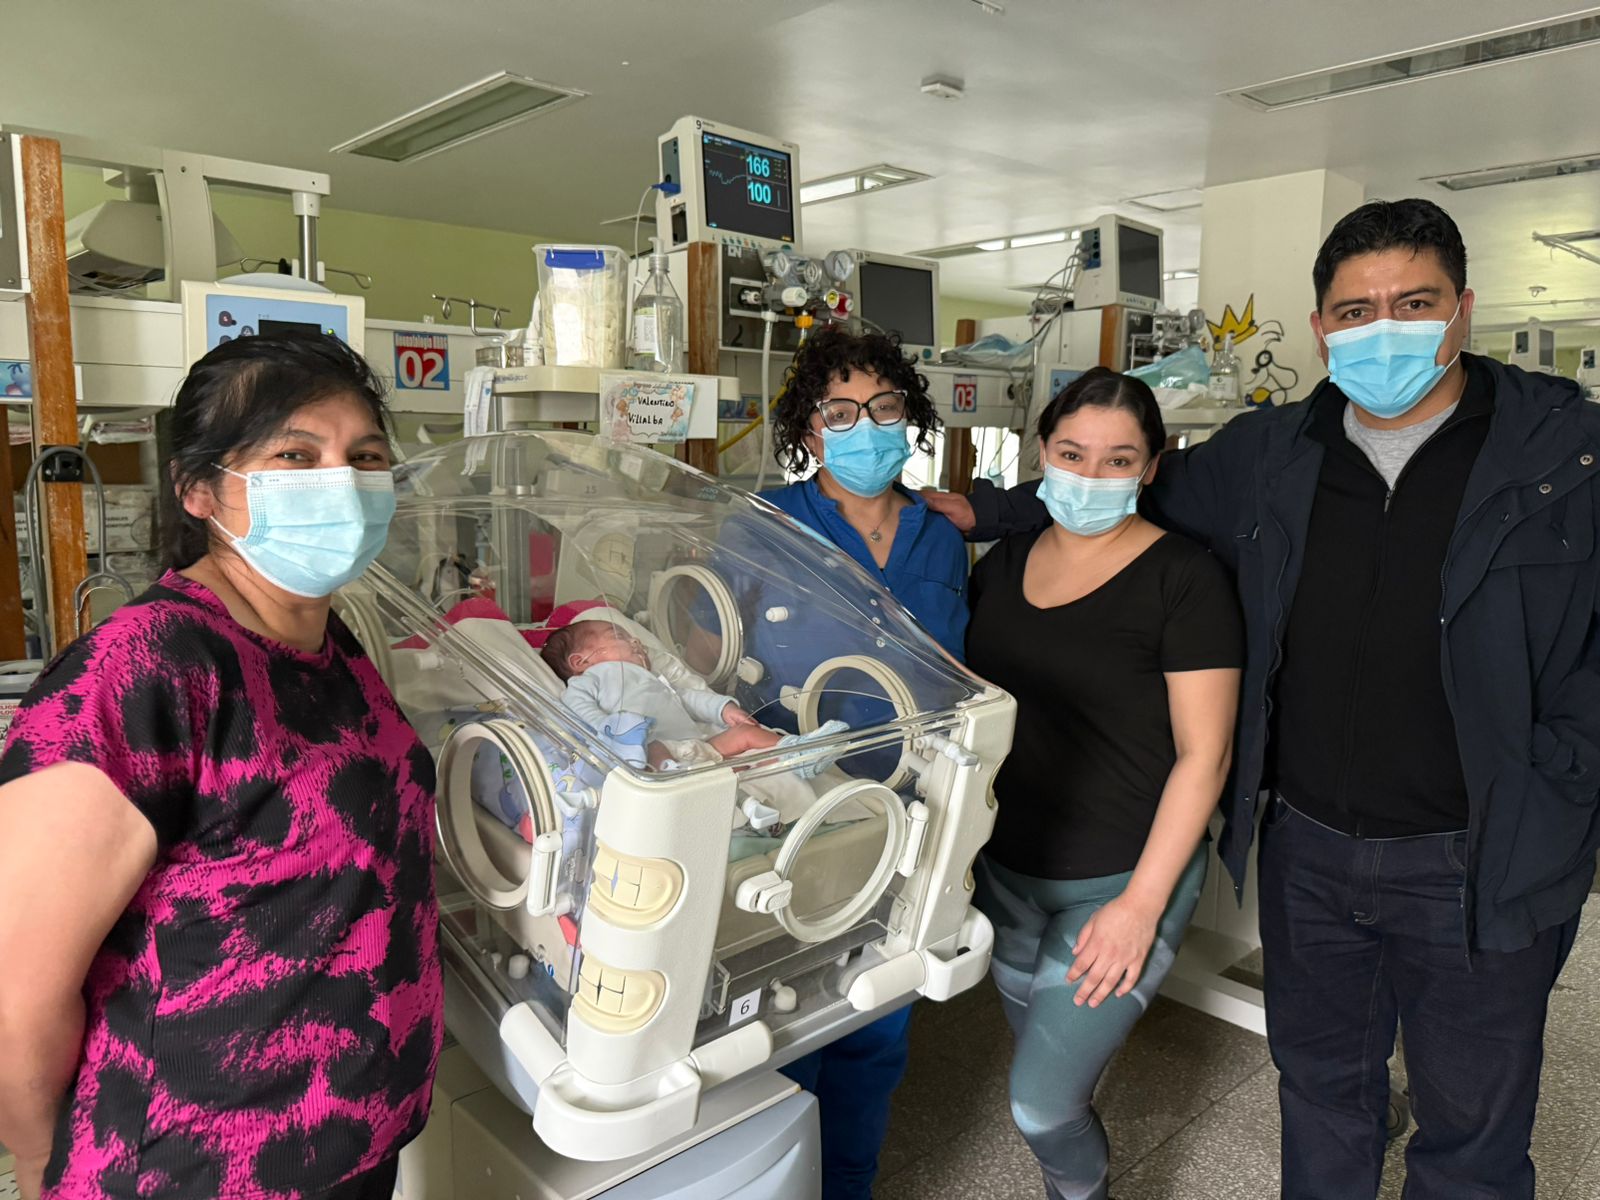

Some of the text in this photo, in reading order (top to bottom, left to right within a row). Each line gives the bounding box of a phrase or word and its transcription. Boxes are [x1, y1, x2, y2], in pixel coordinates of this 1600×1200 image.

[696, 119, 702, 130] 9
[746, 154, 769, 177] 166
[747, 182, 771, 204] 100
[399, 350, 445, 389] 02
[955, 386, 975, 411] 03
[740, 999, 750, 1015] 6
